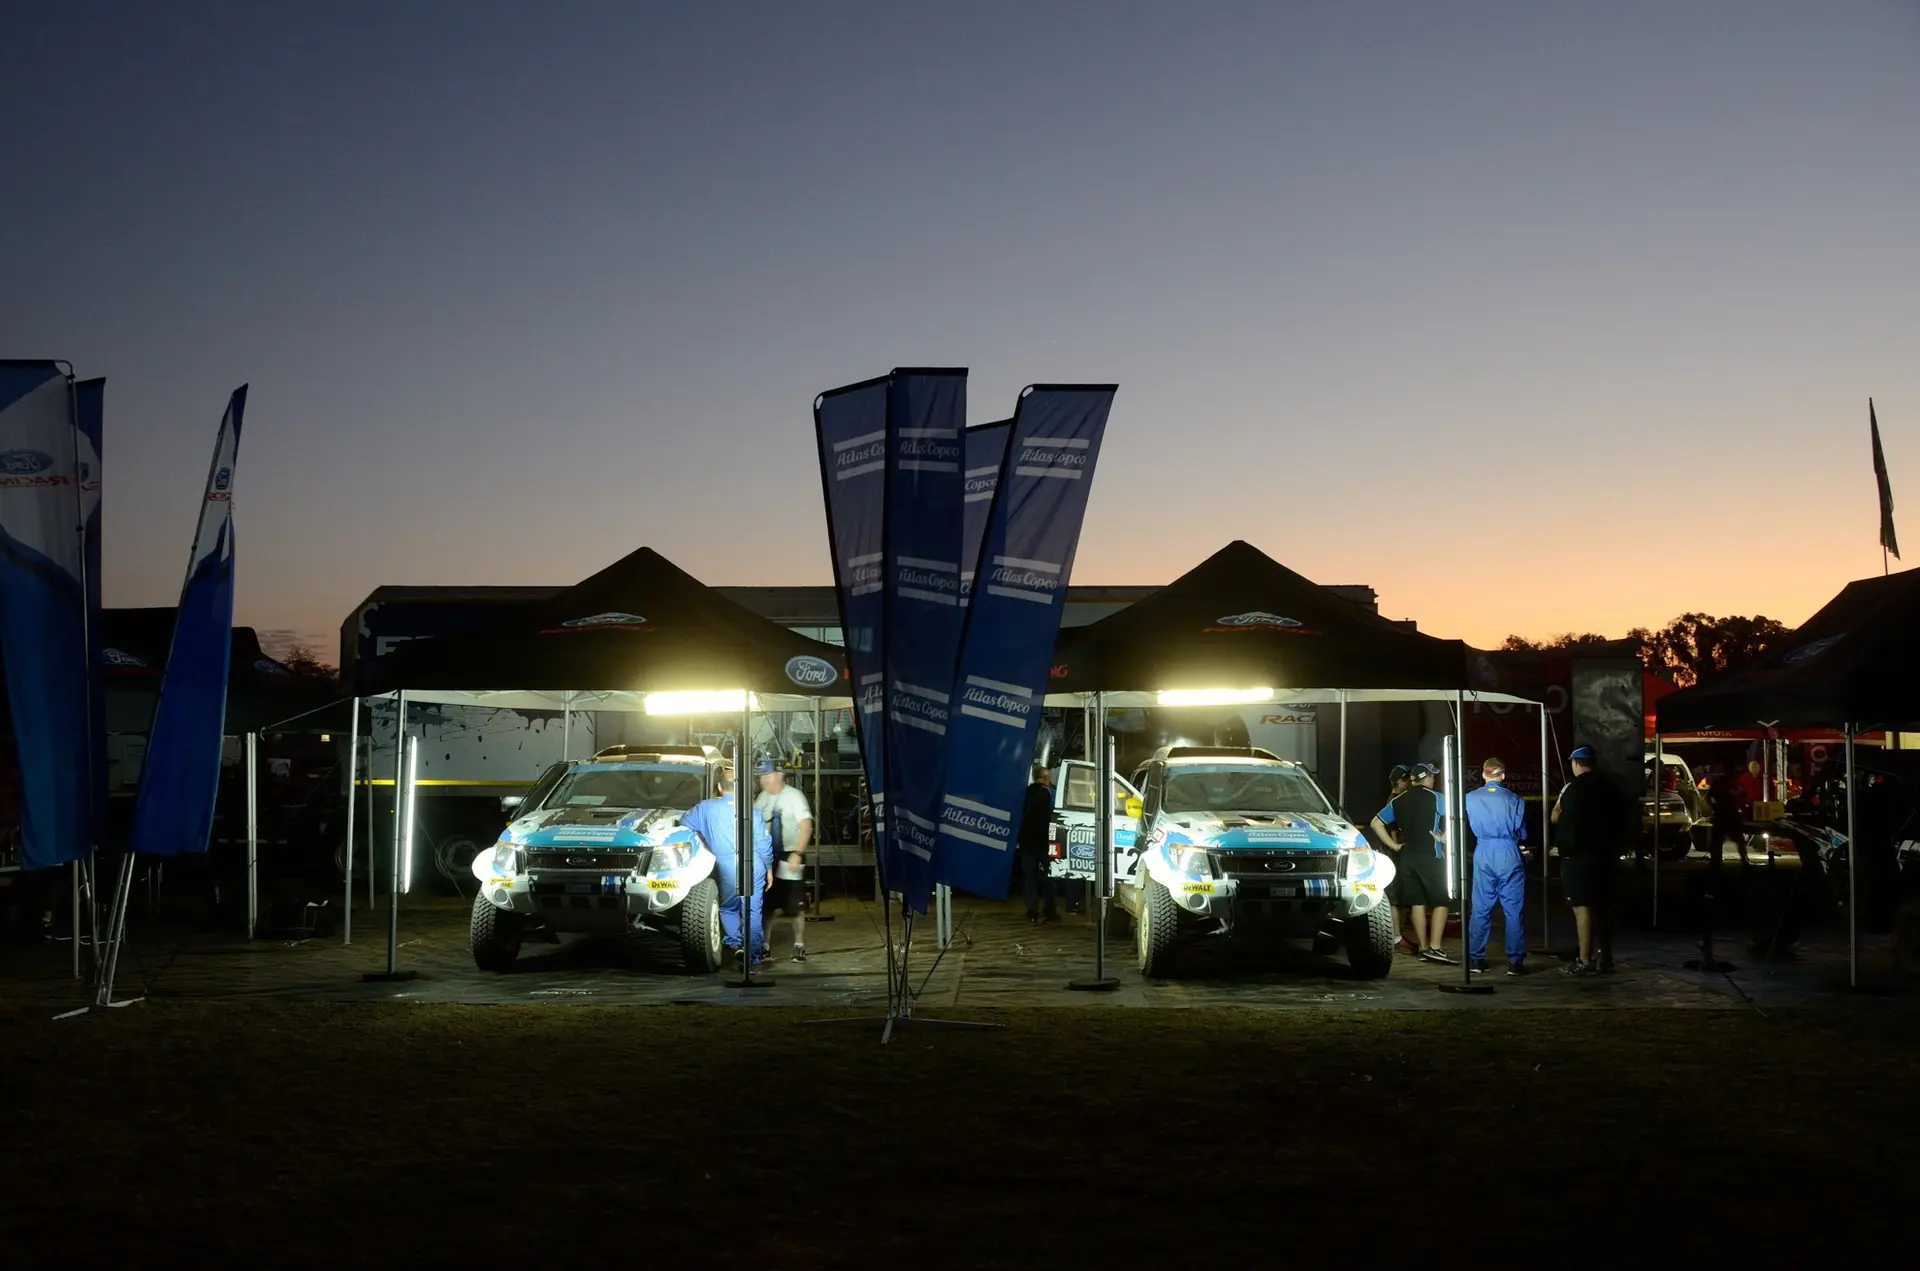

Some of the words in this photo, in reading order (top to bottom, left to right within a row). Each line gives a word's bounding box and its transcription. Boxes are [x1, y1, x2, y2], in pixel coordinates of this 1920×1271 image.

[836, 449, 870, 467] Atlas
[900, 440, 926, 454] Atlas
[927, 441, 960, 459] Copco
[1019, 448, 1054, 463] Atlas
[899, 568, 928, 585] Atlas
[928, 573, 958, 591] Copco
[990, 567, 1022, 584] Atlas
[1023, 572, 1058, 590] Copco
[796, 660, 828, 682] Ford
[863, 684, 882, 700] Atl
[962, 687, 997, 706] Atlas
[996, 695, 1031, 714] Copco
[893, 693, 921, 713] Atlas
[921, 701, 949, 721] Copco
[1260, 714, 1316, 724] RACI
[942, 807, 978, 827] Atlas
[976, 816, 1011, 837] Copco
[1070, 830, 1096, 844] BUIL
[1070, 858, 1096, 871] TOUG
